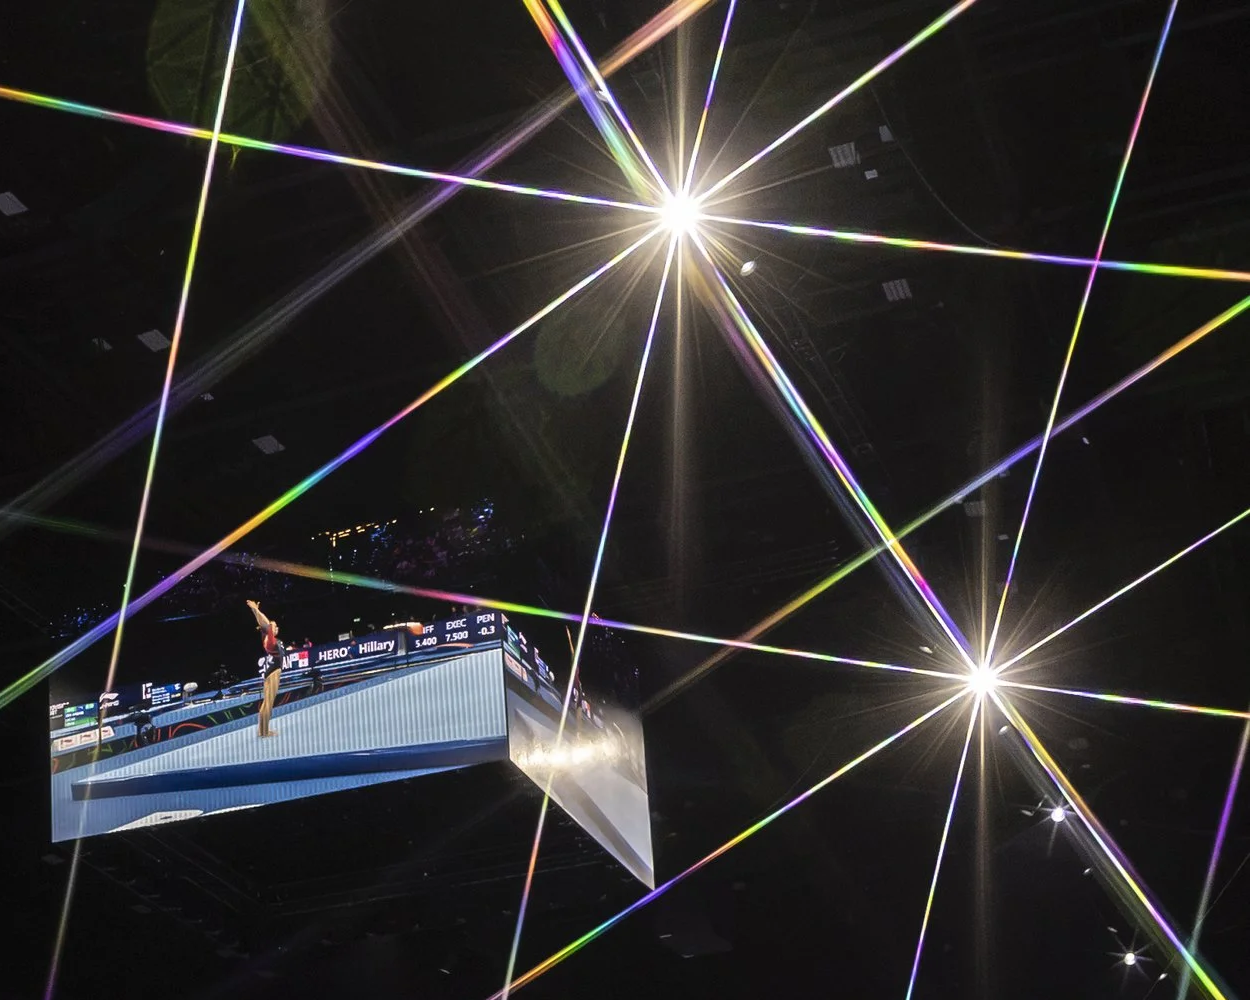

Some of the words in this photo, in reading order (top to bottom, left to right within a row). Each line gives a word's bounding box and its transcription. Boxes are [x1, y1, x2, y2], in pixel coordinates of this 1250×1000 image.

[446, 619, 467, 630] EXEC
[477, 613, 495, 623] PEN
[415, 637, 437, 648] 5.400
[445, 631, 469, 642] 7.500
[478, 626, 495, 636] -0.3
[319, 646, 351, 661] HERO
[359, 640, 395, 654] Hillary
